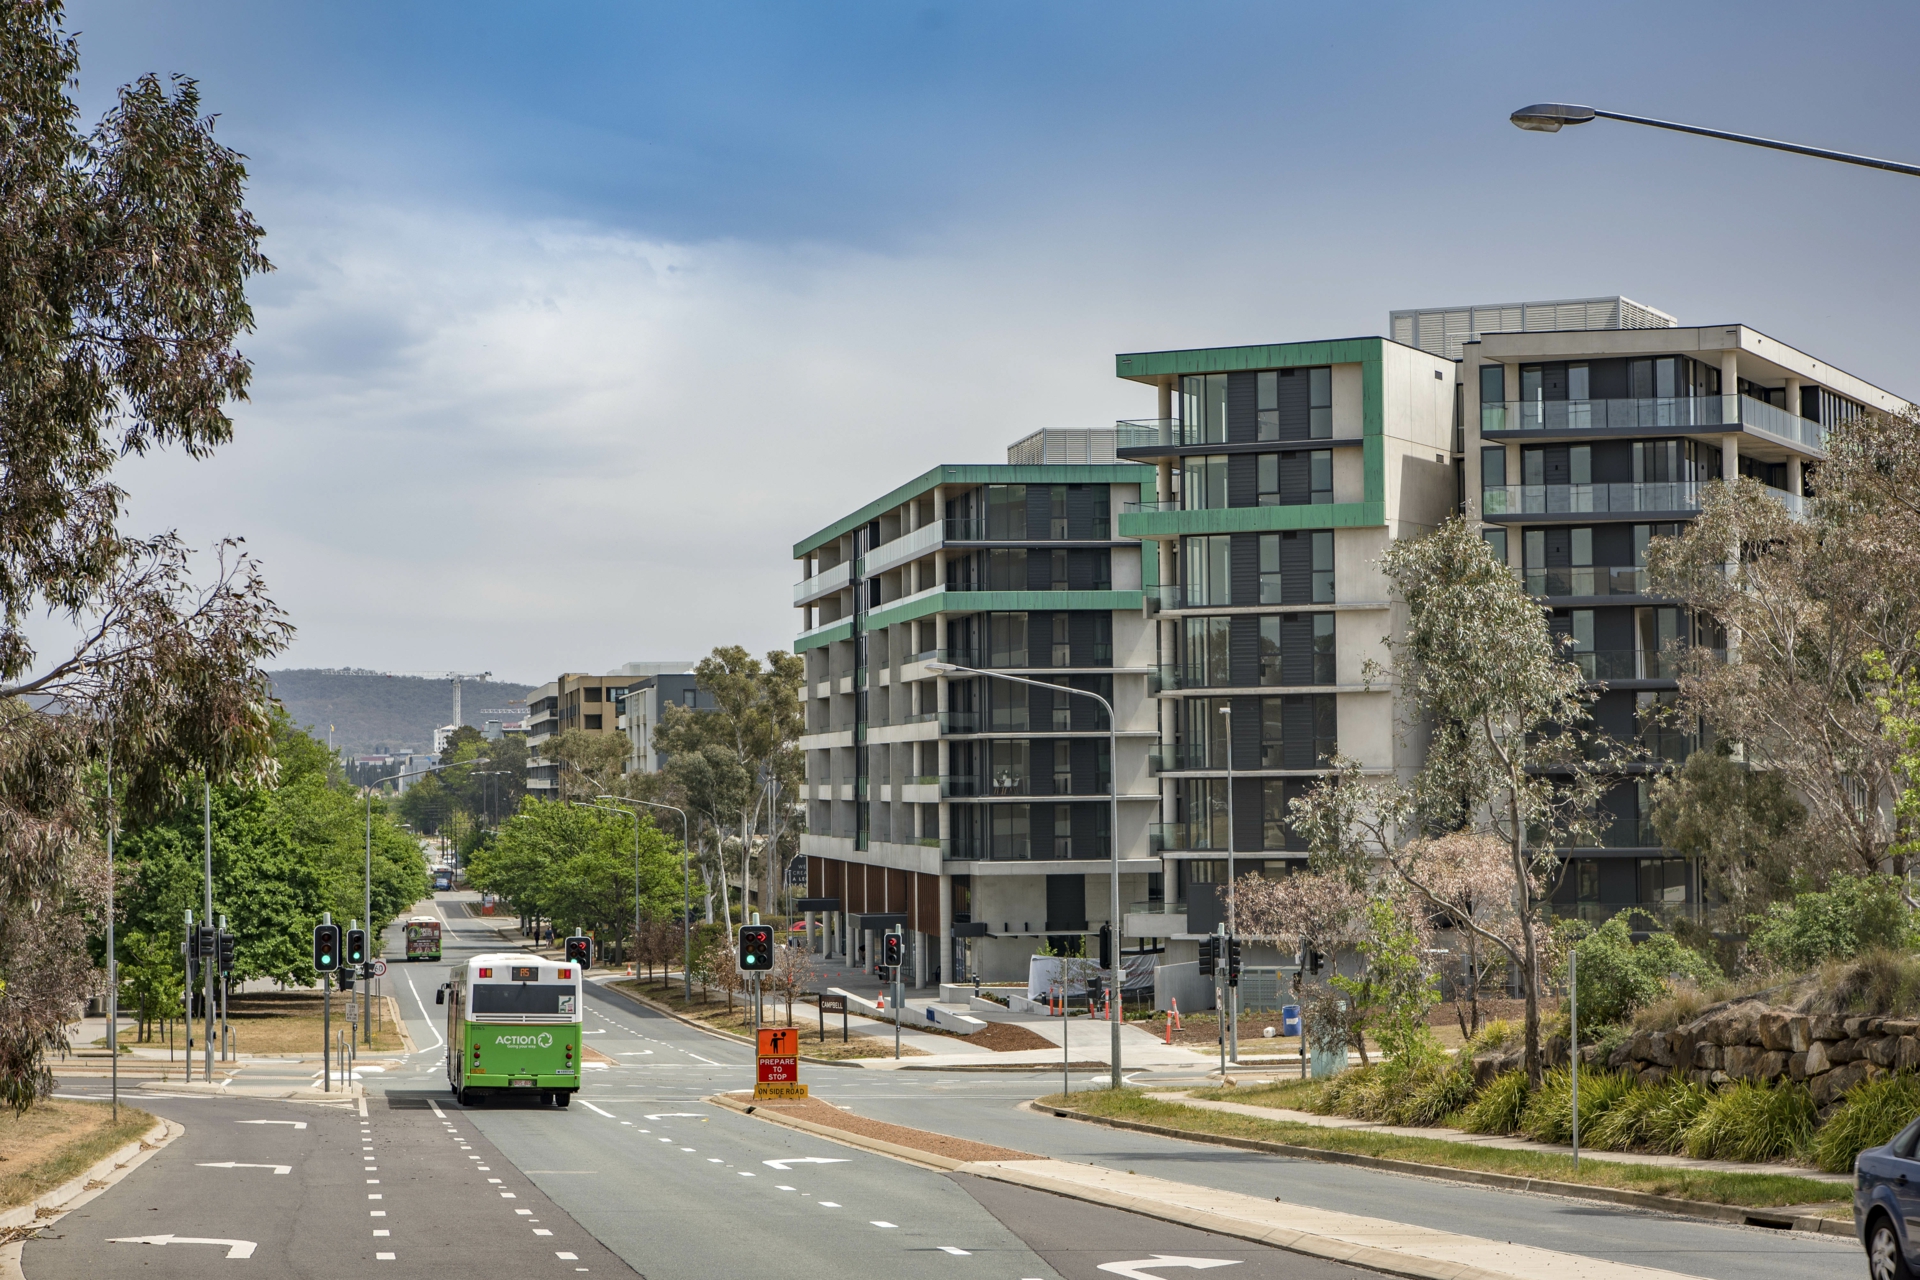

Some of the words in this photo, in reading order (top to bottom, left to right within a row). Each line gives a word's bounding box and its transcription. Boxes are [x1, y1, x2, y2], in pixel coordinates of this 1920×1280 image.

[374, 965, 383, 973] 60
[821, 1000, 844, 1010] CAMPBELL
[760, 1058, 795, 1066] PREPARE
[768, 1073, 787, 1081] STOP
